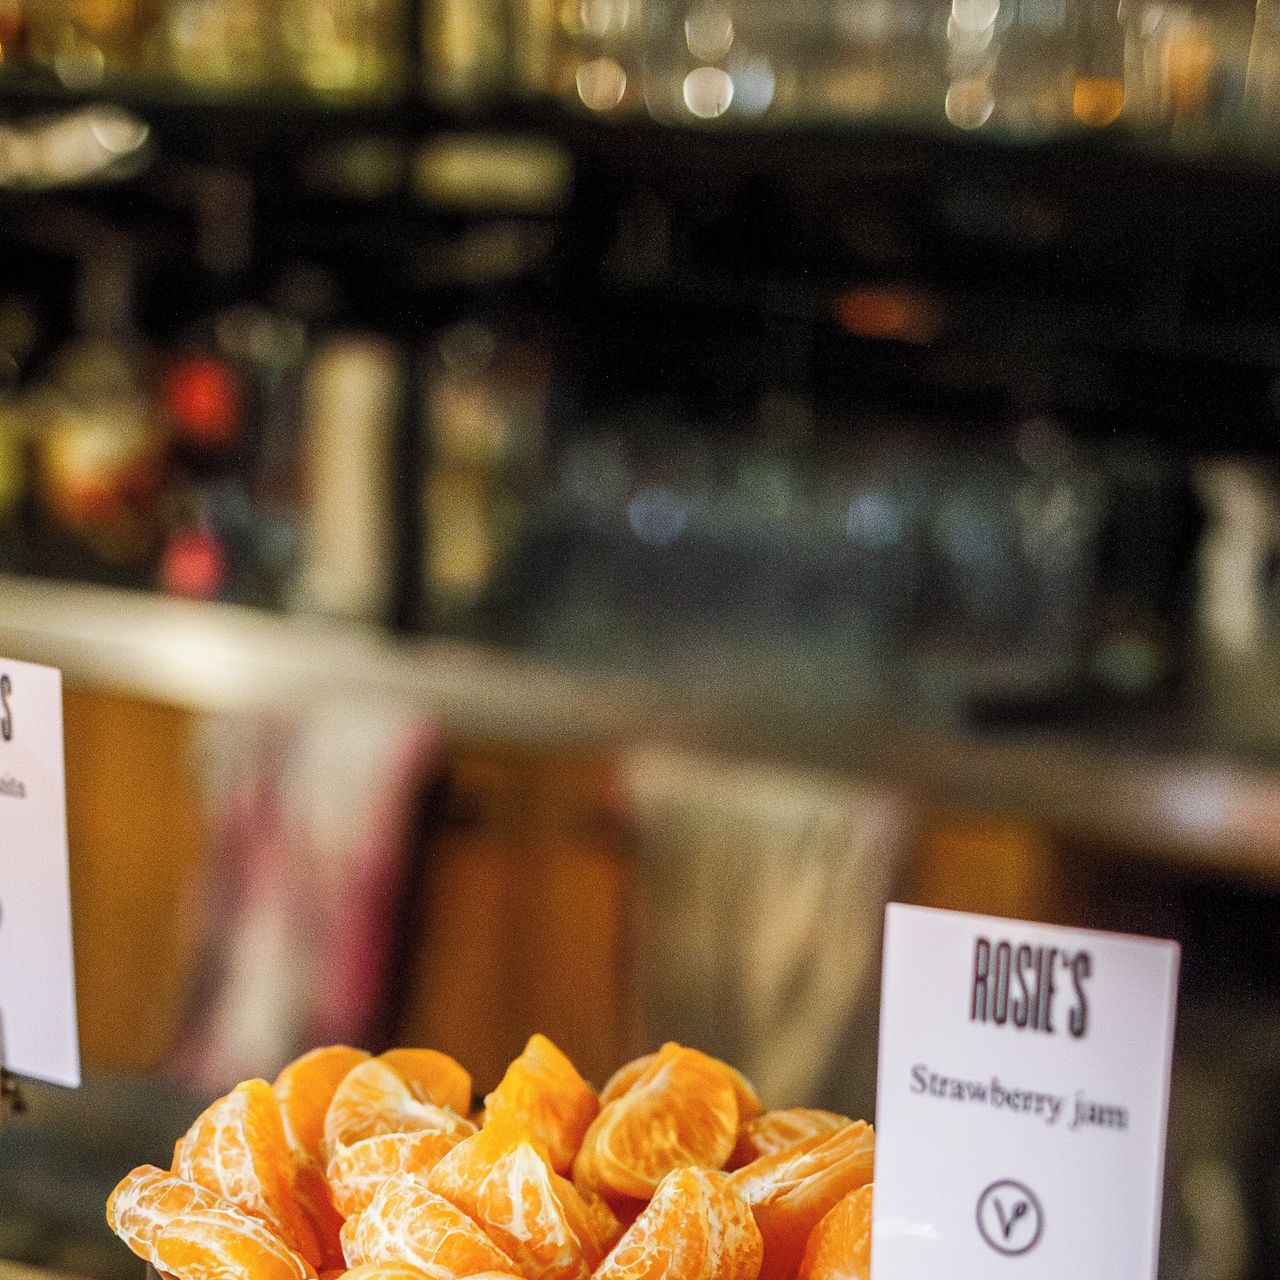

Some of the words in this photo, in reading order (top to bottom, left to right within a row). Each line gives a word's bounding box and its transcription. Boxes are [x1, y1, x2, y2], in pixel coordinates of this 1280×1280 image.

[969, 936, 1093, 1038] ROSIE'S
[909, 1063, 1062, 1124] Strawberry
[1070, 1091, 1129, 1131] jam
